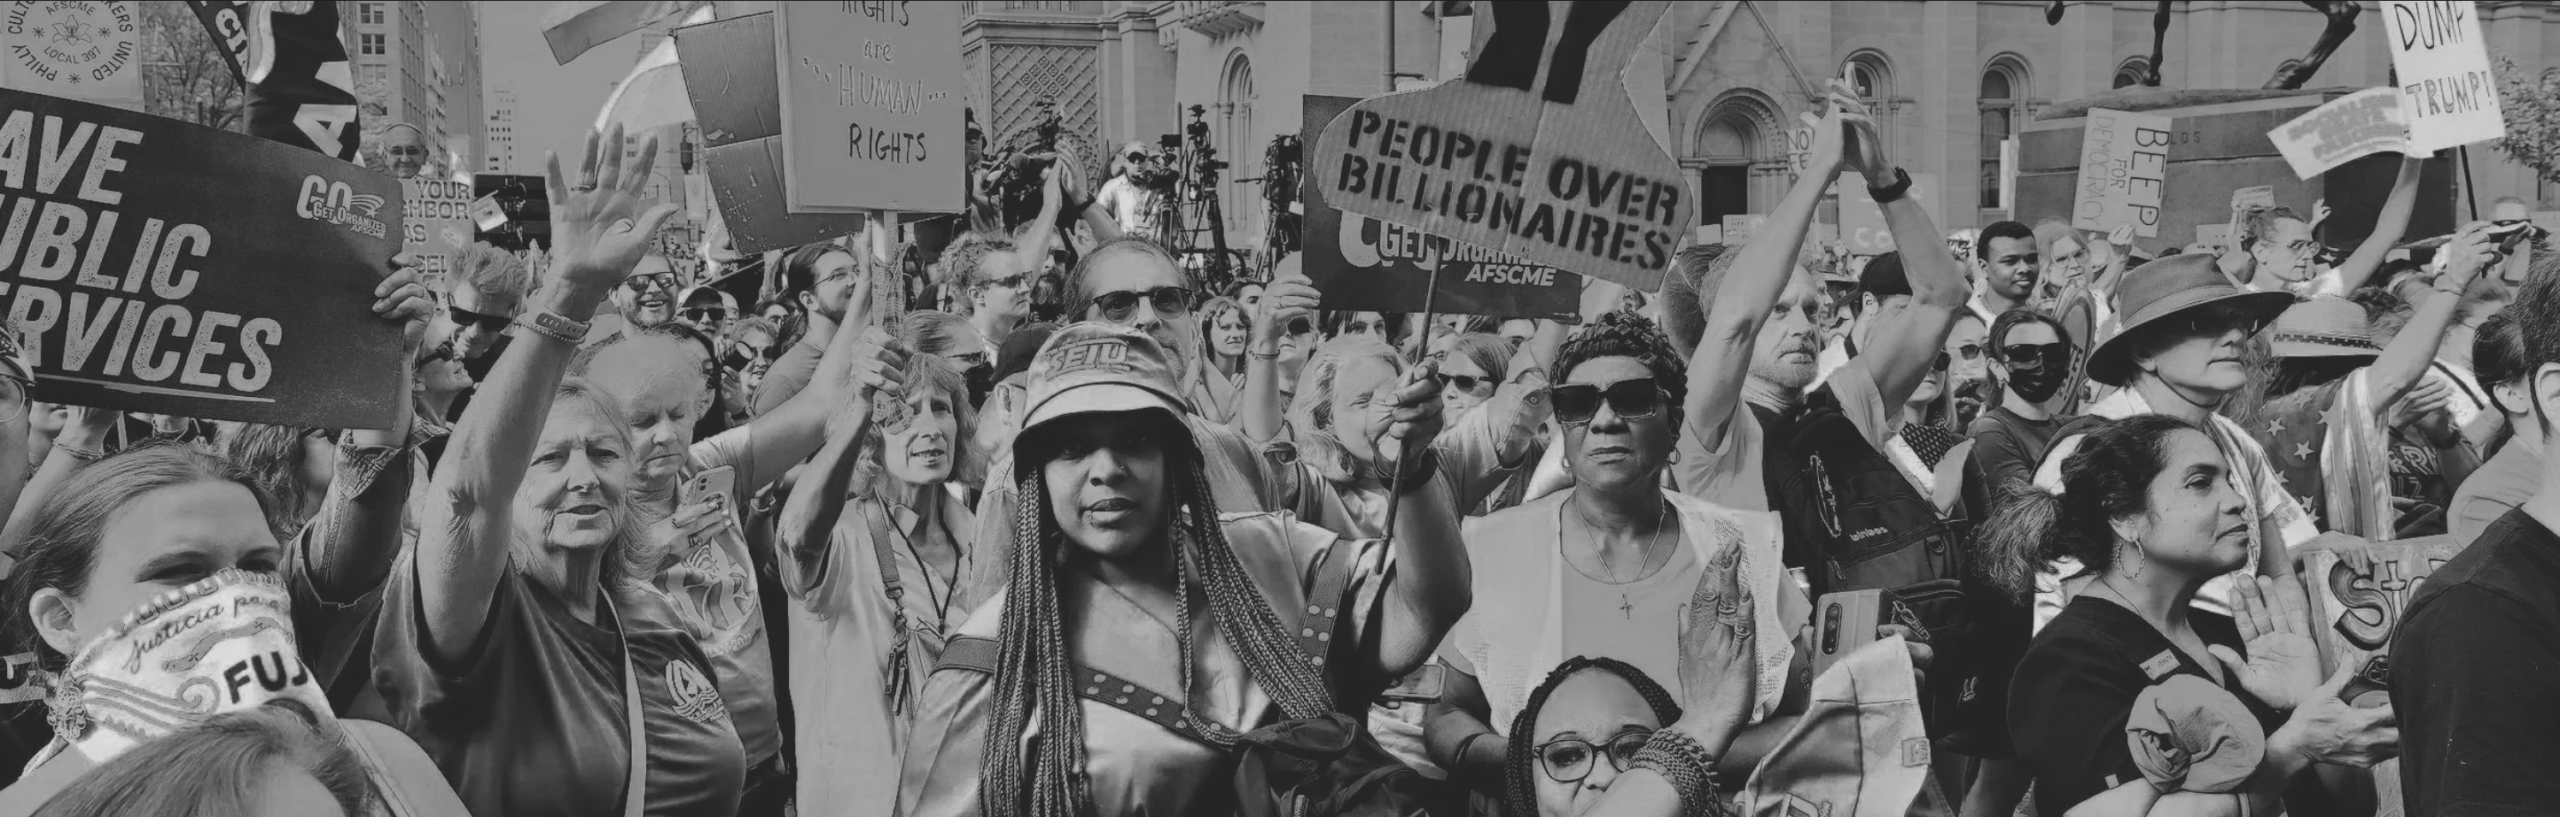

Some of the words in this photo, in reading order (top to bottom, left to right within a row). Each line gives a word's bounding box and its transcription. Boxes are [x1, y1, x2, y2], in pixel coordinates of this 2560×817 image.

[45, 1, 96, 16] AFSCME
[100, 0, 134, 32] KERS
[2394, 1, 2464, 51] DUMP
[11, 44, 58, 82] PHILLY
[43, 45, 79, 65] LOCAL
[81, 45, 101, 62] 397
[92, 40, 133, 81] UNITED
[864, 40, 893, 62] are
[2405, 71, 2493, 118] TRUMP!
[849, 122, 926, 164] RIGHTS
[1349, 109, 1531, 187] PEOPLE
[1548, 157, 1679, 227] OVER
[2081, 116, 2116, 227] DEMOCRACY
[2110, 158, 2127, 189] FOR
[2128, 127, 2170, 226] BEEP
[416, 180, 470, 200] YOUR
[313, 201, 335, 220] GET
[337, 206, 387, 234] ORGANIZED
[1338, 152, 1671, 271] BILLIONAIRES
[1465, 263, 1557, 287] AFSCME
[1045, 340, 1129, 381] SEIU
[2328, 558, 2430, 651] St
[122, 604, 224, 675] justicia
